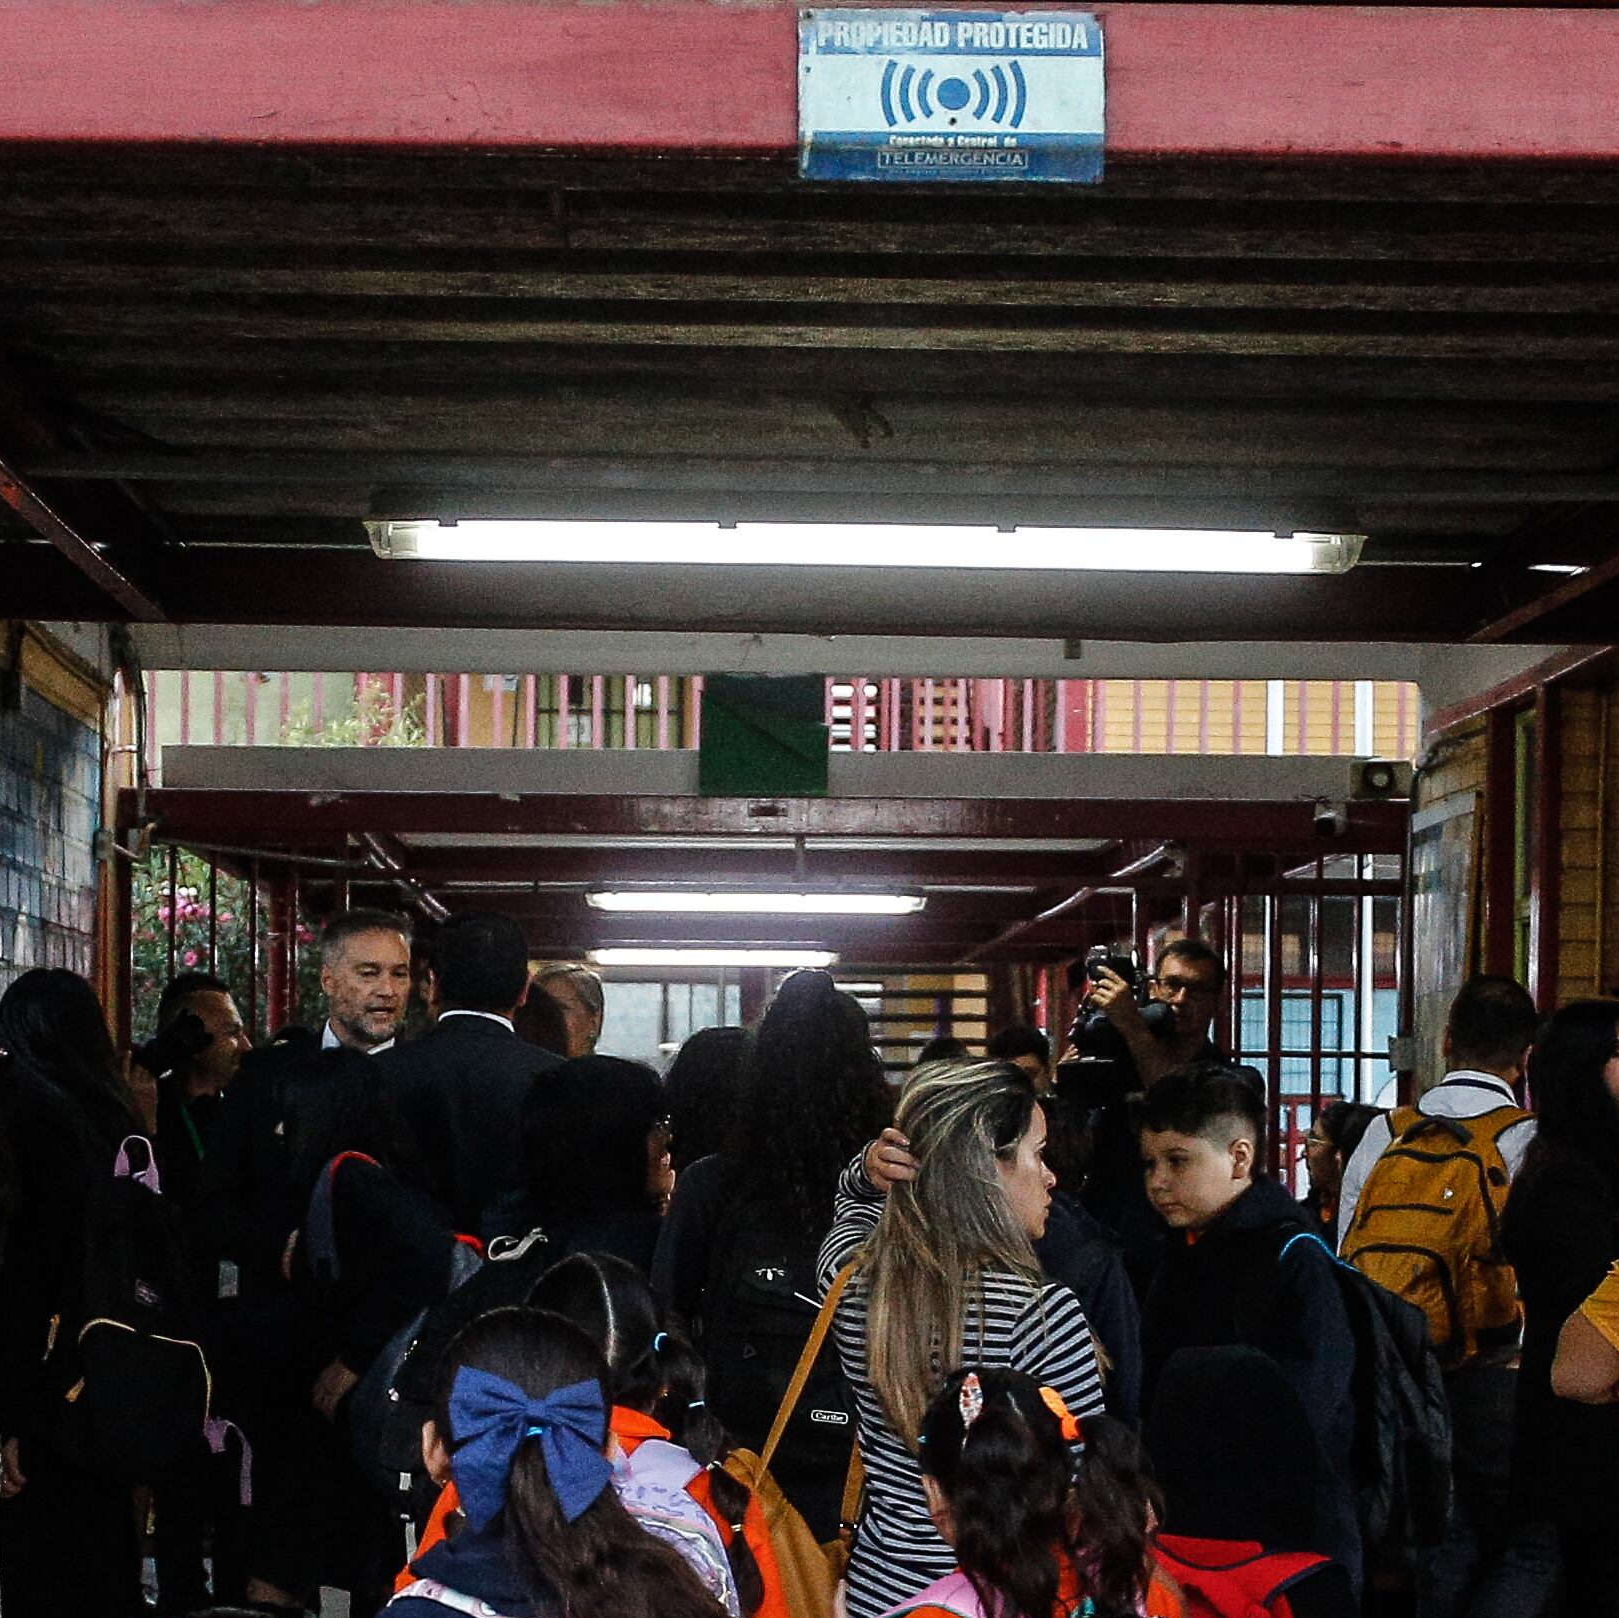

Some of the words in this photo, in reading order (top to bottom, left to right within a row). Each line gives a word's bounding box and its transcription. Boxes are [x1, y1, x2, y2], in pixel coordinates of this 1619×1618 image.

[818, 22, 950, 47] PROPIEDAD
[957, 23, 1089, 49] PROTEGIDA
[883, 152, 1024, 166] TELEMERGENCIA
